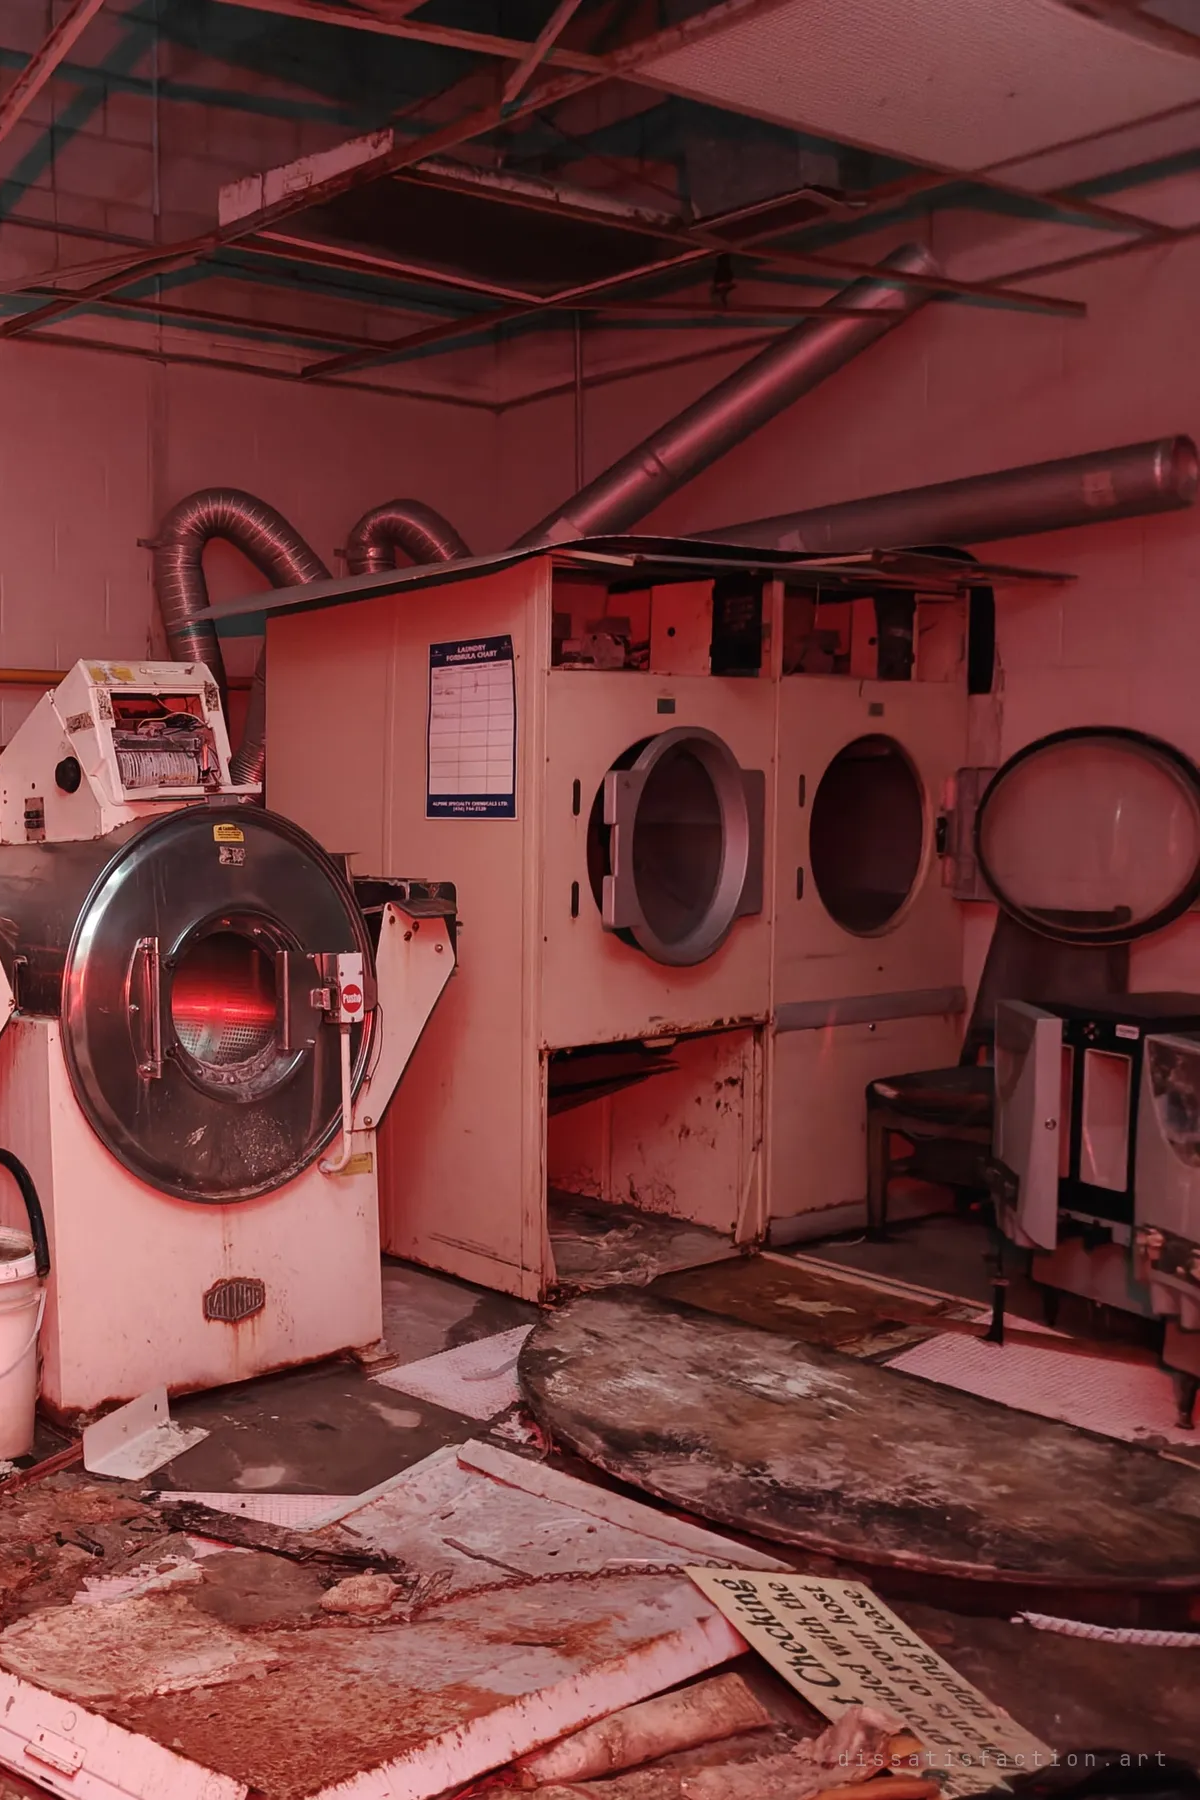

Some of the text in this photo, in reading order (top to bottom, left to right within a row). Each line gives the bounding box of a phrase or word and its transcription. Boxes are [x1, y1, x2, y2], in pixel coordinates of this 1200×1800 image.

[446, 653, 476, 662] FORMULA
[477, 650, 497, 659] CHART
[457, 644, 486, 653] LAUNDRY
[768, 1581, 807, 1610] the
[801, 1584, 860, 1626] host
[713, 1577, 841, 1688] Checking
[795, 1615, 852, 1656] with
[847, 1629, 914, 1674] your
[843, 1588, 996, 1719] tipping please
[837, 1662, 964, 1747] provided
[888, 1675, 932, 1697] of
